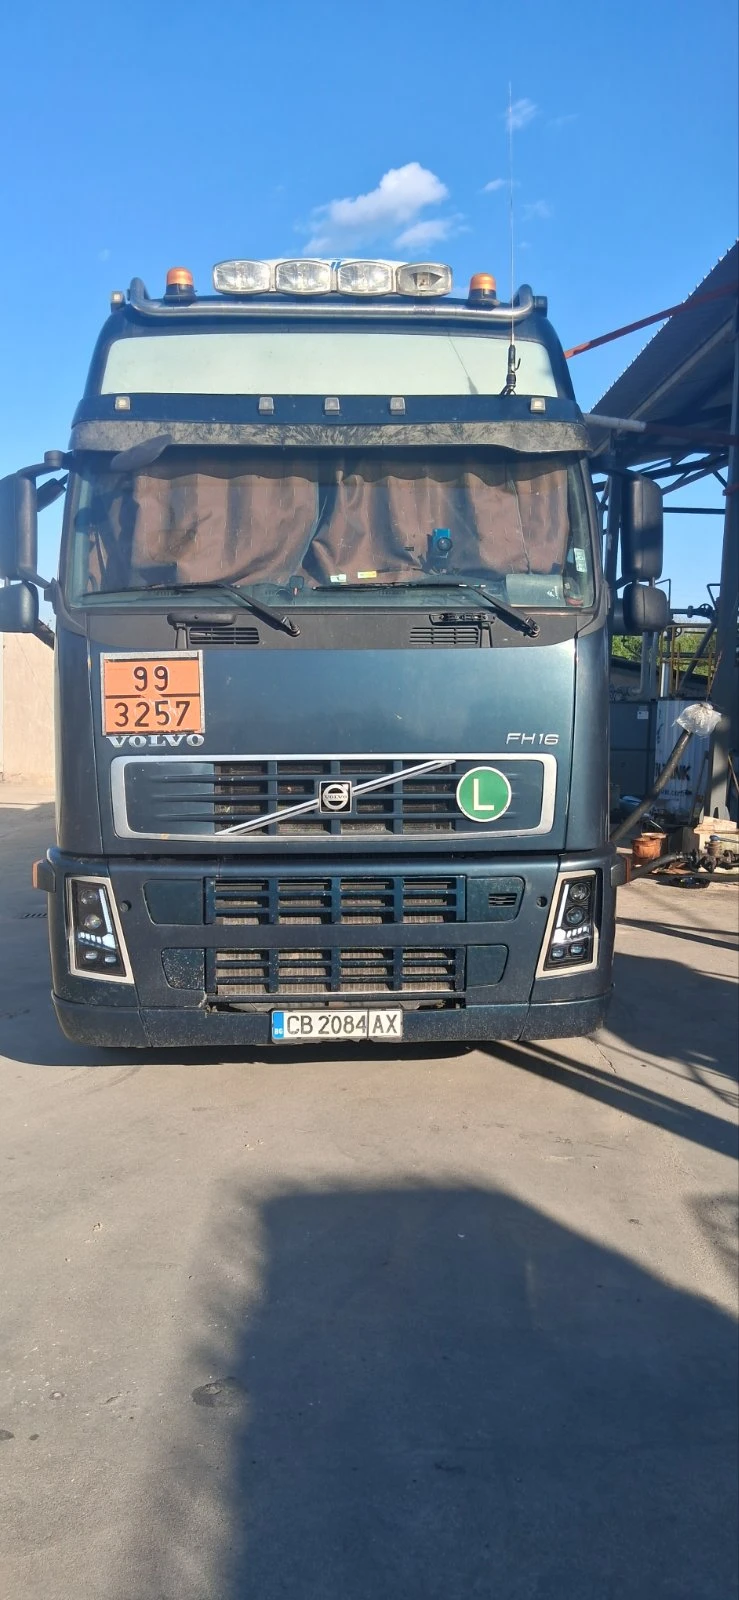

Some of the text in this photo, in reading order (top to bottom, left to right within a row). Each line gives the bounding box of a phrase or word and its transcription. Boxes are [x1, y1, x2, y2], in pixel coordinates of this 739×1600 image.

[133, 666, 168, 691] 99
[114, 701, 191, 727] 3257
[106, 734, 205, 747] VOLVO
[506, 733, 559, 745] FH16
[473, 778, 494, 811] L
[287, 1014, 398, 1035] CB 2084 AX
